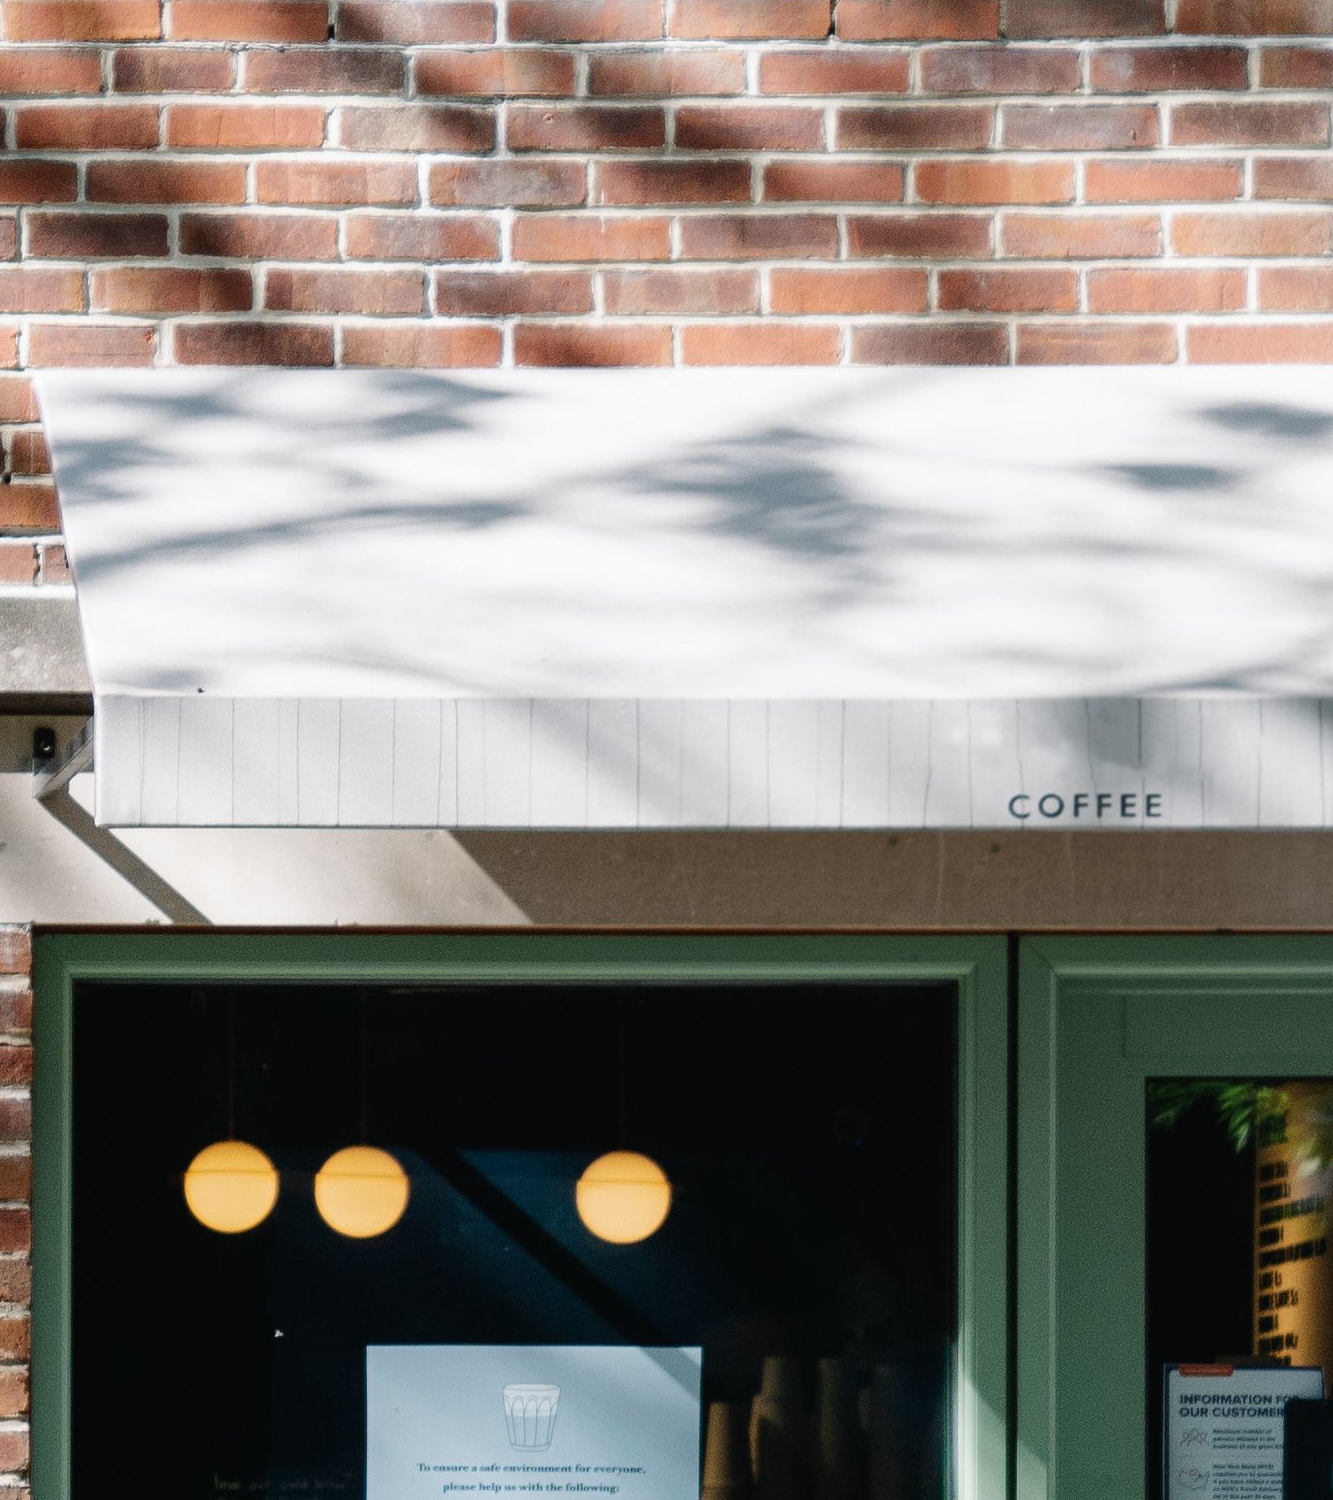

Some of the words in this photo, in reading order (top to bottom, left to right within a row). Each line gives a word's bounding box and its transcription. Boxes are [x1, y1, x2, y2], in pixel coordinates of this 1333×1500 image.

[1008, 793, 1162, 819] COFFEE
[1180, 1394, 1273, 1405] INFORMATION
[1180, 1407, 1208, 1418] OUR
[1213, 1407, 1285, 1418] CUSTOMER
[417, 1463, 430, 1472] To
[480, 1463, 501, 1472] safe
[503, 1464, 572, 1472] environment
[575, 1464, 591, 1472] for
[594, 1466, 645, 1475] everyone,
[443, 1482, 476, 1493] please
[479, 1482, 502, 1493] help
[519, 1482, 543, 1492] with
[546, 1483, 562, 1492] the
[566, 1482, 620, 1494] following:
